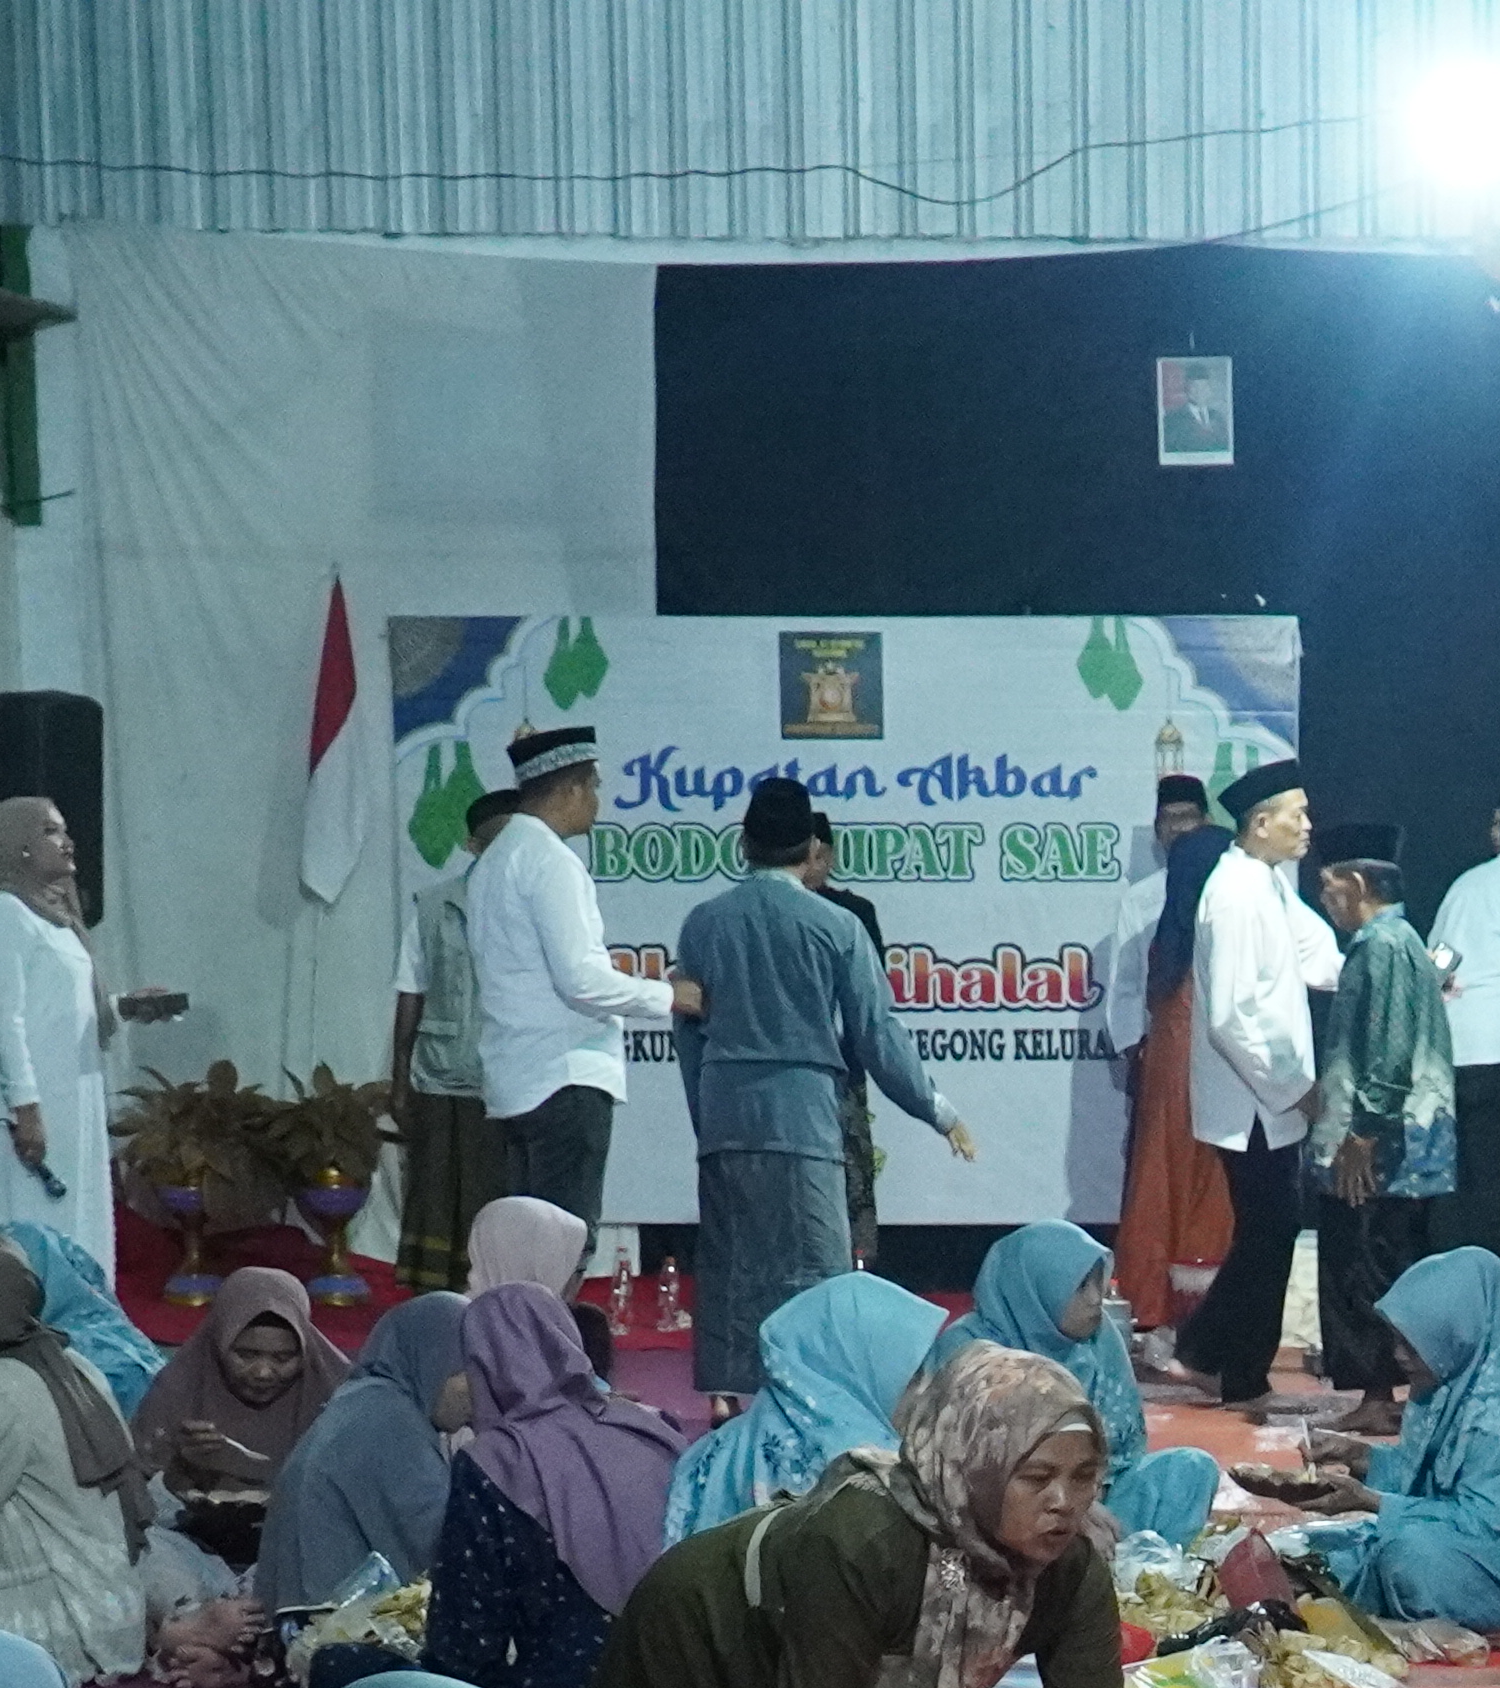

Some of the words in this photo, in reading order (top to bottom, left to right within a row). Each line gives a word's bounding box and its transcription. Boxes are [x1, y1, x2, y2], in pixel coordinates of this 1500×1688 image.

[897, 751, 1098, 806] Akbar
[829, 821, 985, 883] UPAT
[1000, 821, 1122, 883] SAE
[886, 942, 1105, 1011] ihalal
[908, 1027, 1005, 1061] EGONG
